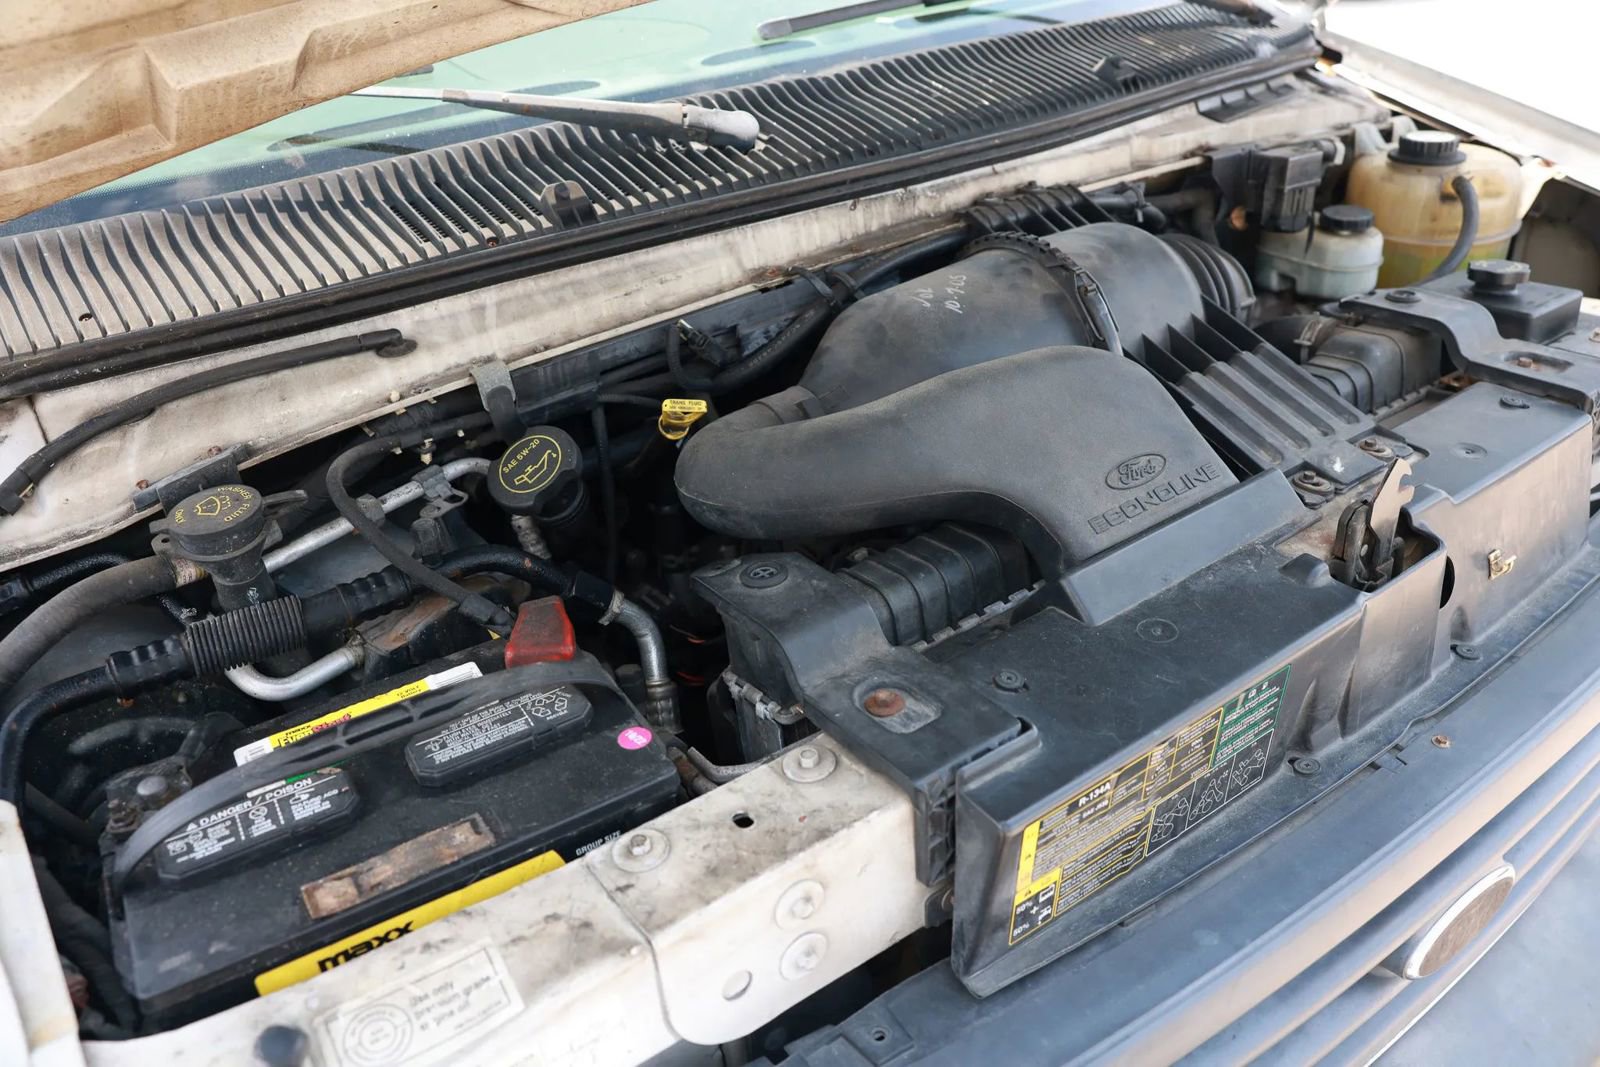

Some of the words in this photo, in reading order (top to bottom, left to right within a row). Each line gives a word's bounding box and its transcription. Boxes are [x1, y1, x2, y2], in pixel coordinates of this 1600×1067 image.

[502, 458, 519, 474] SAE
[516, 438, 540, 461] 5W-20
[1118, 458, 1156, 486] Ford
[224, 503, 250, 522] FLUID
[1087, 463, 1221, 535] ECONOLINE
[200, 800, 252, 825] DANGER
[265, 778, 312, 800] POISON
[1079, 782, 1110, 807] R-134A
[576, 838, 604, 856] GROUP
[604, 830, 621, 841] SIZE
